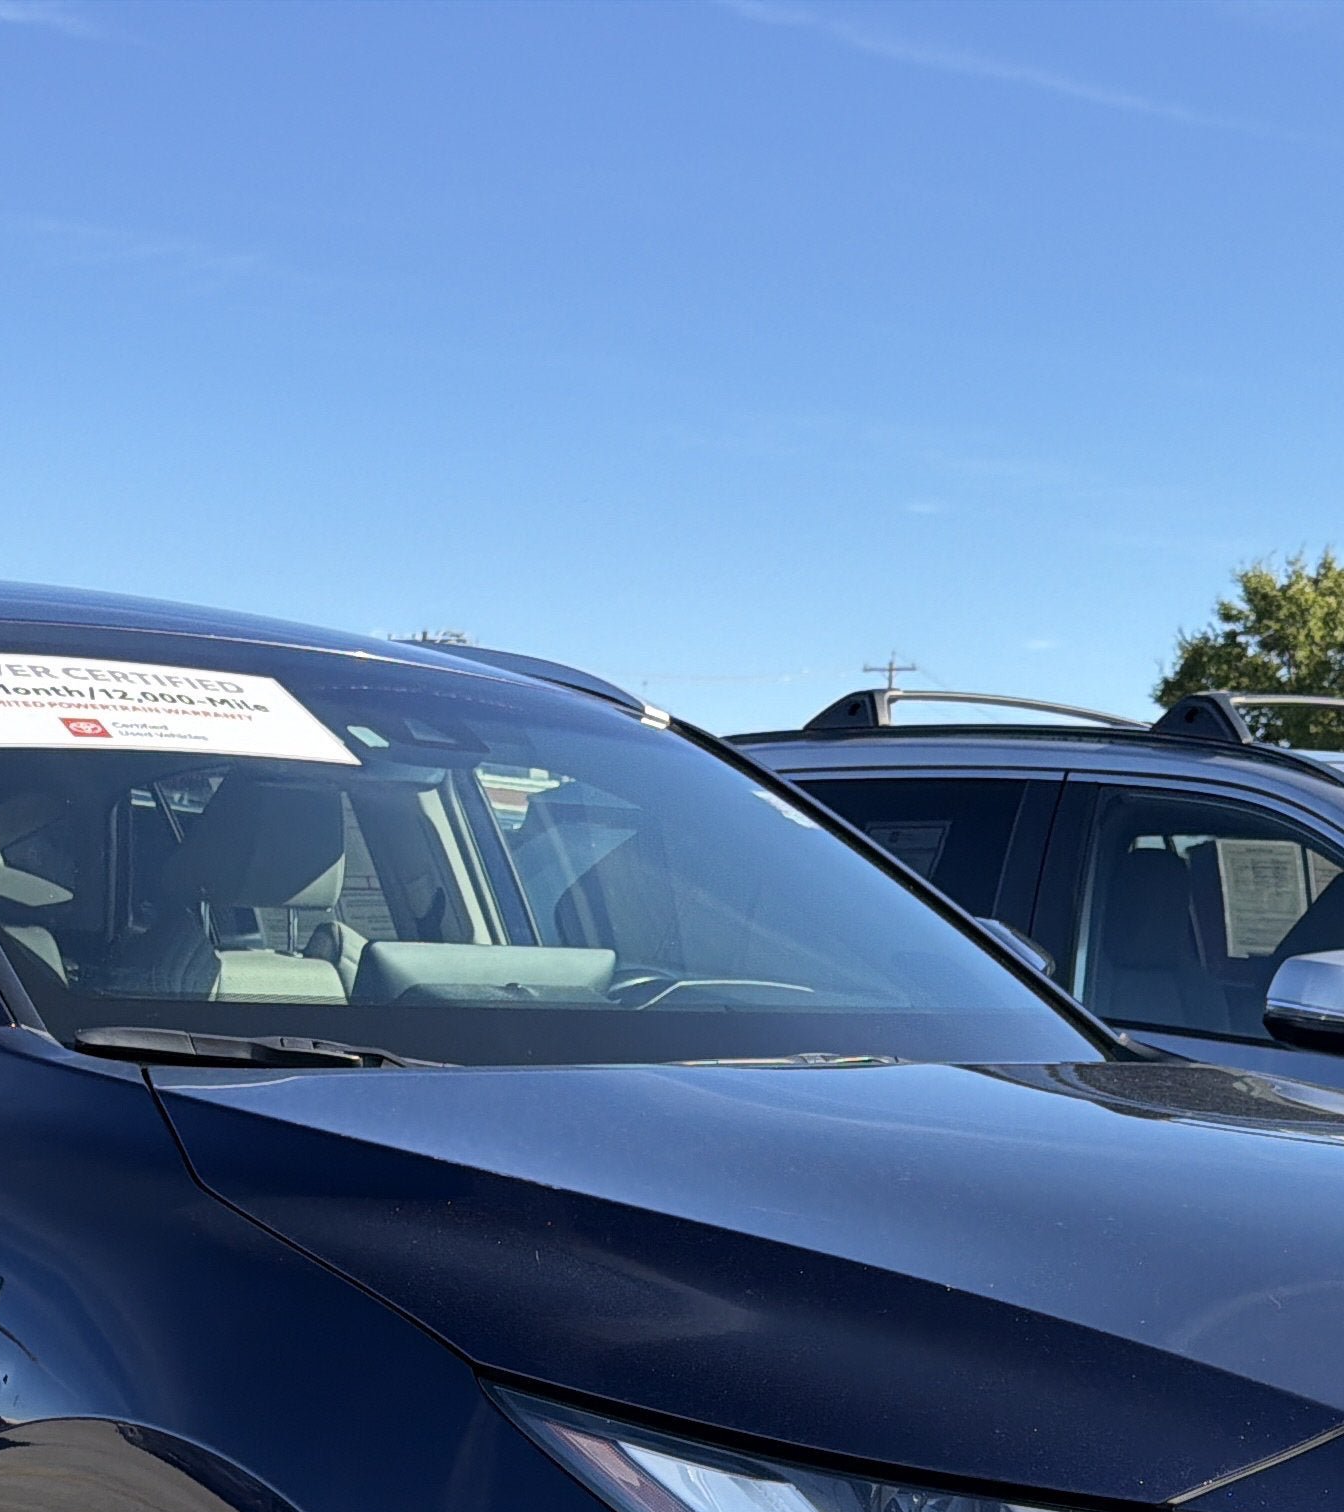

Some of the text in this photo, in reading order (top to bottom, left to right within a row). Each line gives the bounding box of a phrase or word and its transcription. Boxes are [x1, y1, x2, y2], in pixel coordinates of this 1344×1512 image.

[61, 667, 245, 694] CERTIFIED
[47, 701, 161, 714] POWERTRAIN
[162, 708, 253, 721] WARRANTY
